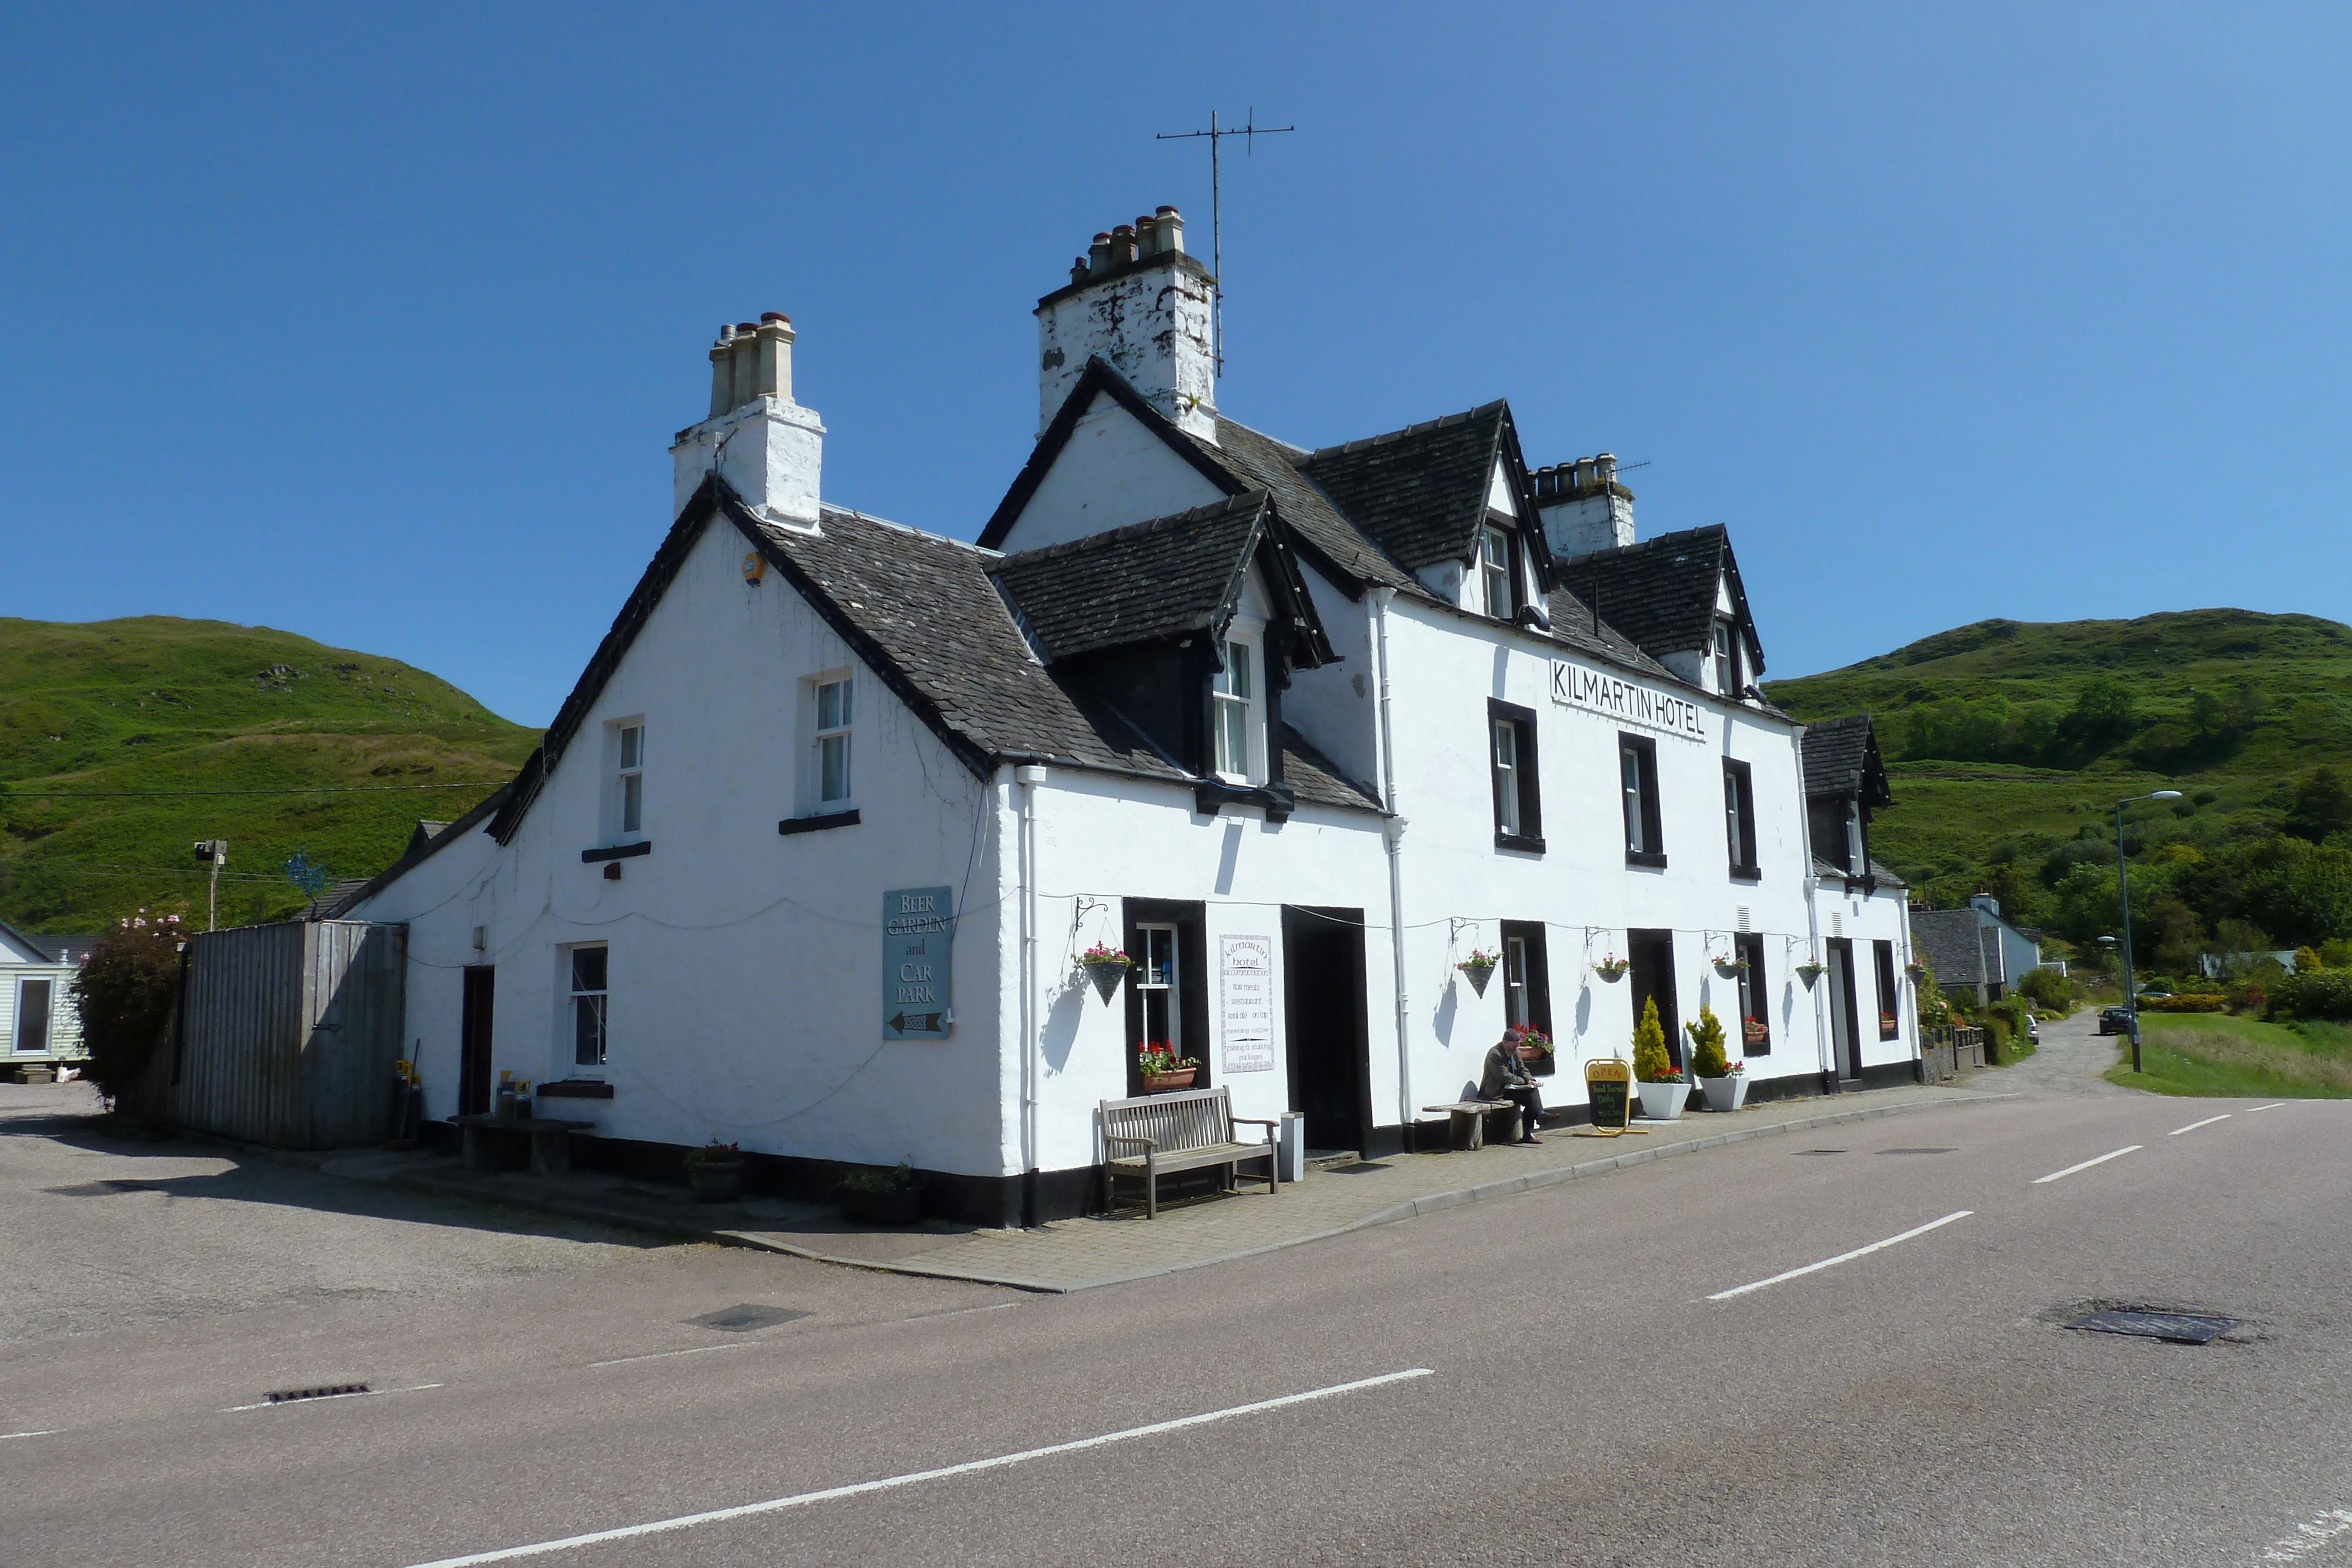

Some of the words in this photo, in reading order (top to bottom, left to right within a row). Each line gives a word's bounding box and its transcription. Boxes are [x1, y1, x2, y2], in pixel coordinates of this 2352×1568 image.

[1553, 661, 1652, 720] KILMARTIN
[1655, 693, 1705, 735] HOTEL
[900, 894, 936, 914] BEER
[887, 915, 947, 936] GARDEN
[906, 939, 926, 955] and
[1232, 957, 1259, 966] hotel
[899, 963, 933, 983] CAR
[896, 986, 936, 1004] PARK
[1593, 1068, 1622, 1079] OPEN
